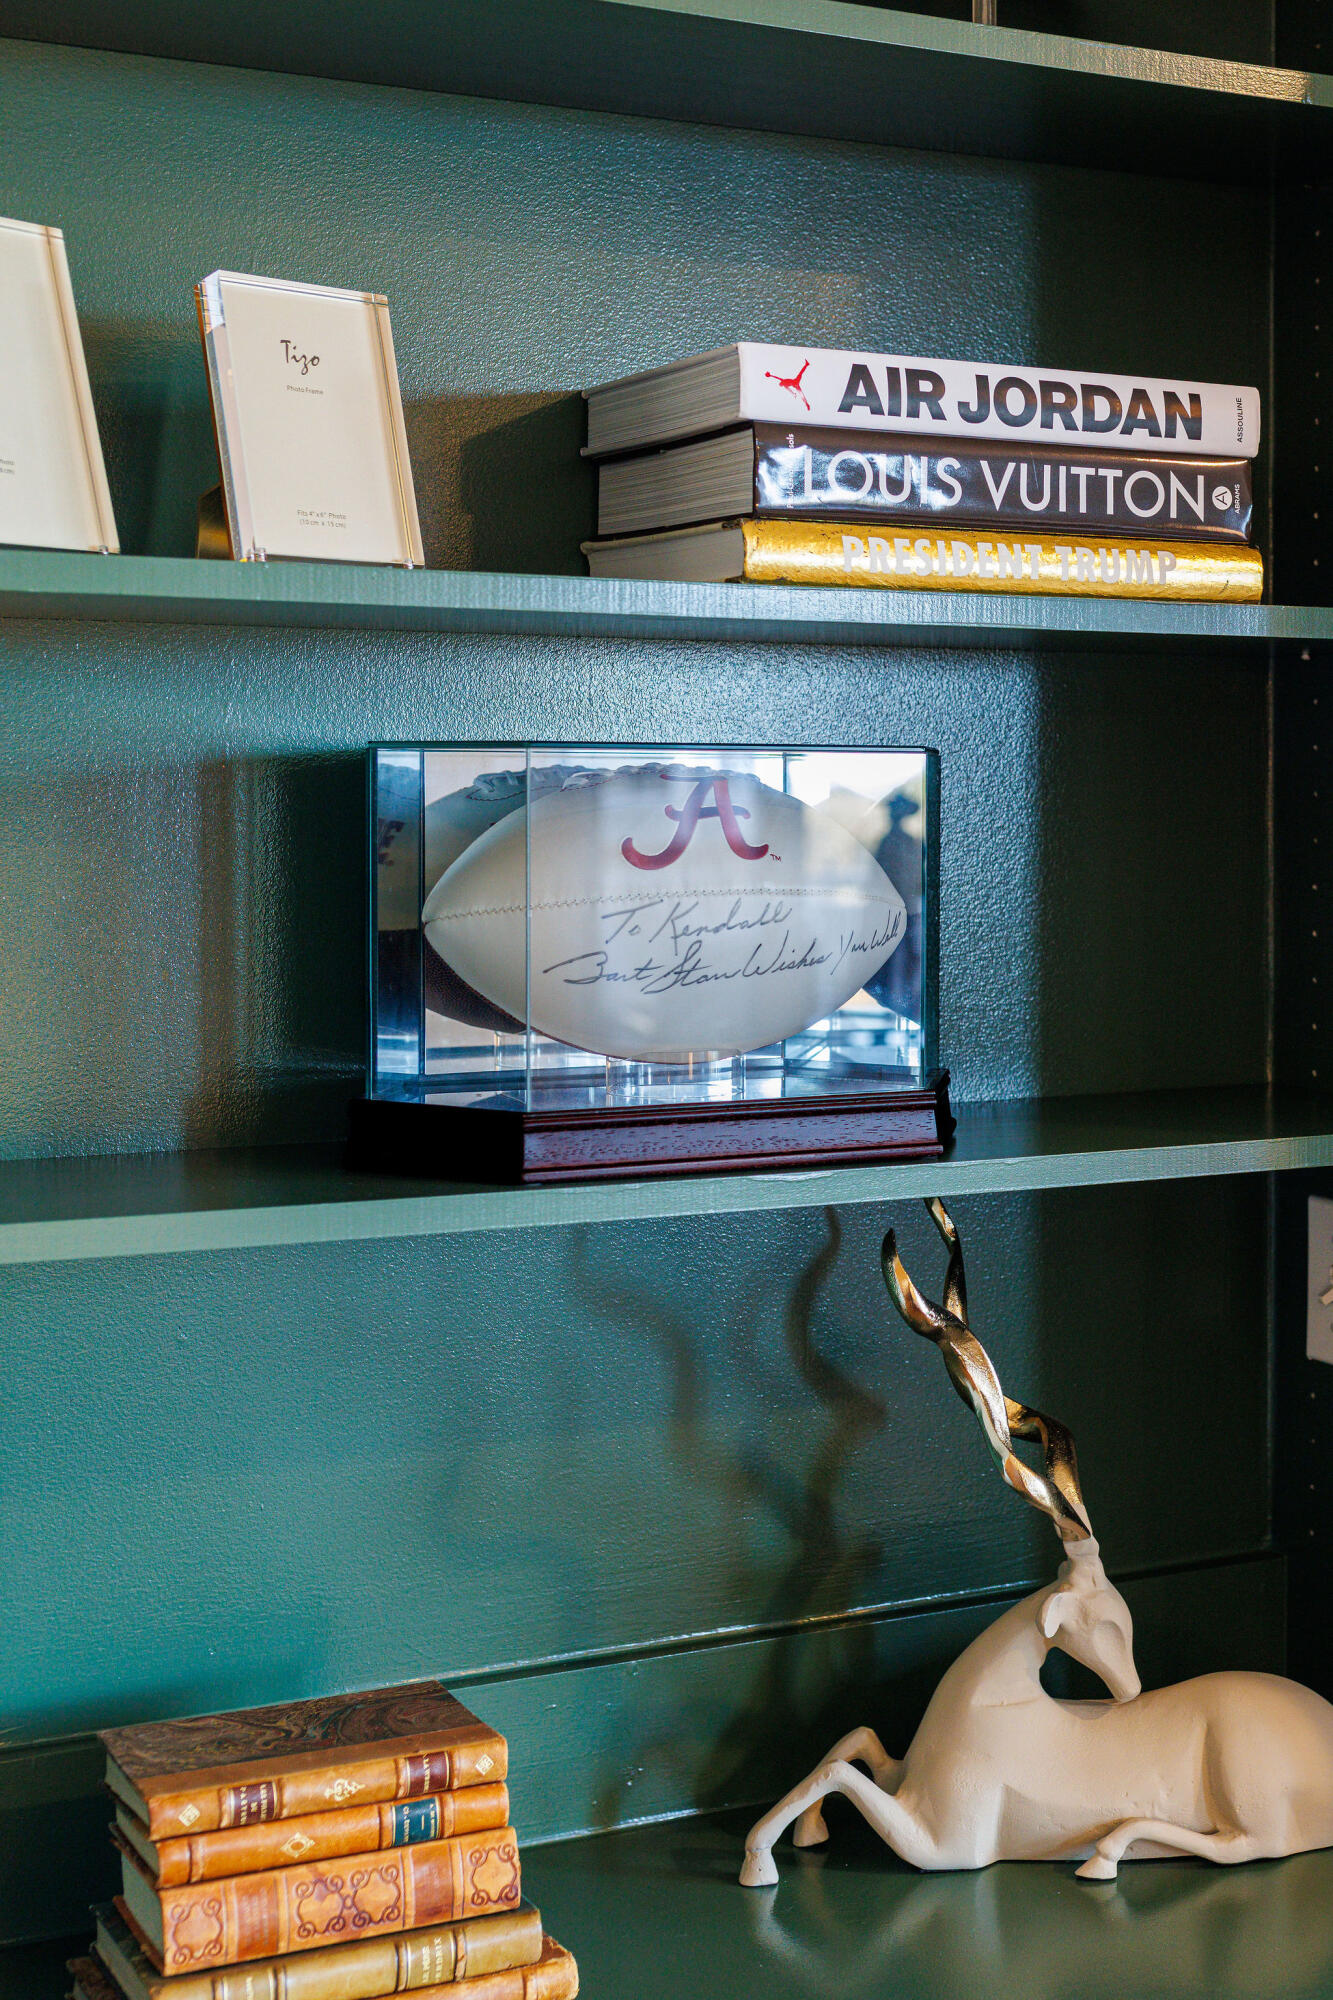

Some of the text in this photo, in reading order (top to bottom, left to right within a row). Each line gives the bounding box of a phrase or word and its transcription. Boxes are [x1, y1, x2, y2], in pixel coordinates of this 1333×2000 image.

[280, 339, 320, 375] Tizo
[837, 363, 1203, 441] AIR JORDAN
[804, 448, 963, 507] LOUIS
[980, 460, 1204, 523] VUITTON
[841, 535, 1178, 586] PRESIDENT TRUMP
[601, 898, 792, 956] To Kendall
